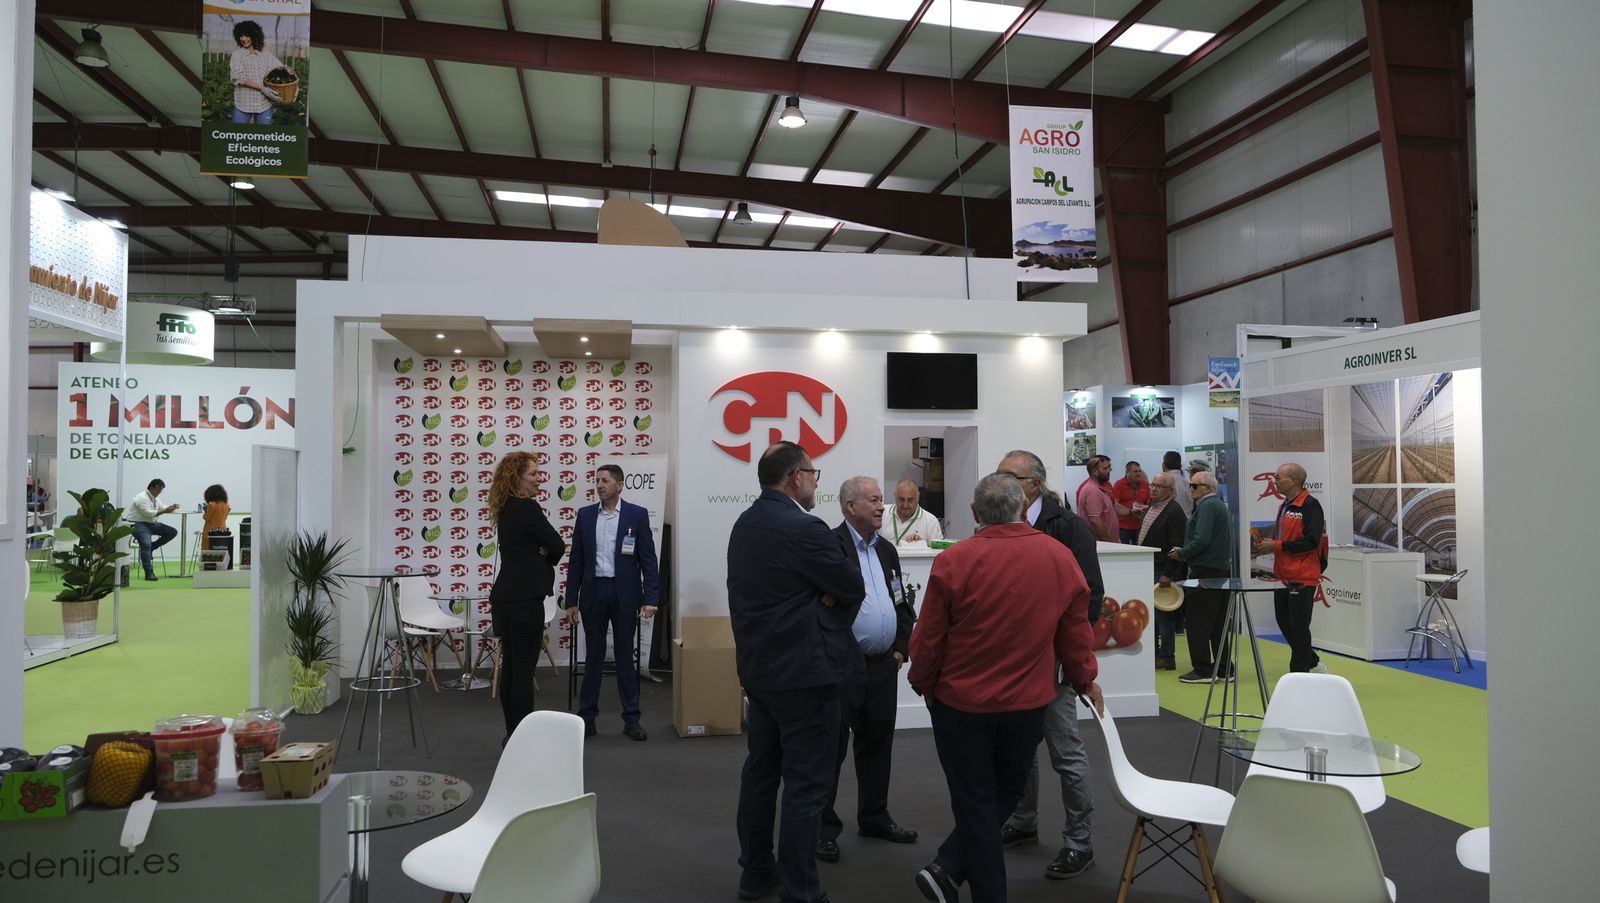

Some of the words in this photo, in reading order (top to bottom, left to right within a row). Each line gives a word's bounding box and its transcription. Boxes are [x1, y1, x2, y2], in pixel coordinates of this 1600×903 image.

[211, 130, 297, 143] Comprometidos
[1019, 128, 1081, 148] AGRO
[228, 143, 280, 154] Eficientes
[1032, 146, 1050, 154] SAN
[1052, 147, 1081, 156] ISIDRO
[225, 155, 282, 168] Ecológicos
[1041, 198, 1058, 207] CAMPOS
[1058, 199, 1066, 207] DEL
[1066, 199, 1084, 207] LEVANTE
[78, 275, 93, 302] de
[1343, 348, 1402, 370] AGROINVER
[1405, 346, 1417, 361] SL
[69, 392, 93, 428] 1
[108, 386, 295, 430] MILLÓN
[69, 433, 92, 445] DE
[97, 433, 197, 446] TONELADAS
[69, 448, 92, 459] DE
[97, 448, 170, 460] GRACIAS
[624, 473, 656, 490] COPE
[0, 849, 181, 884] denijar.es
